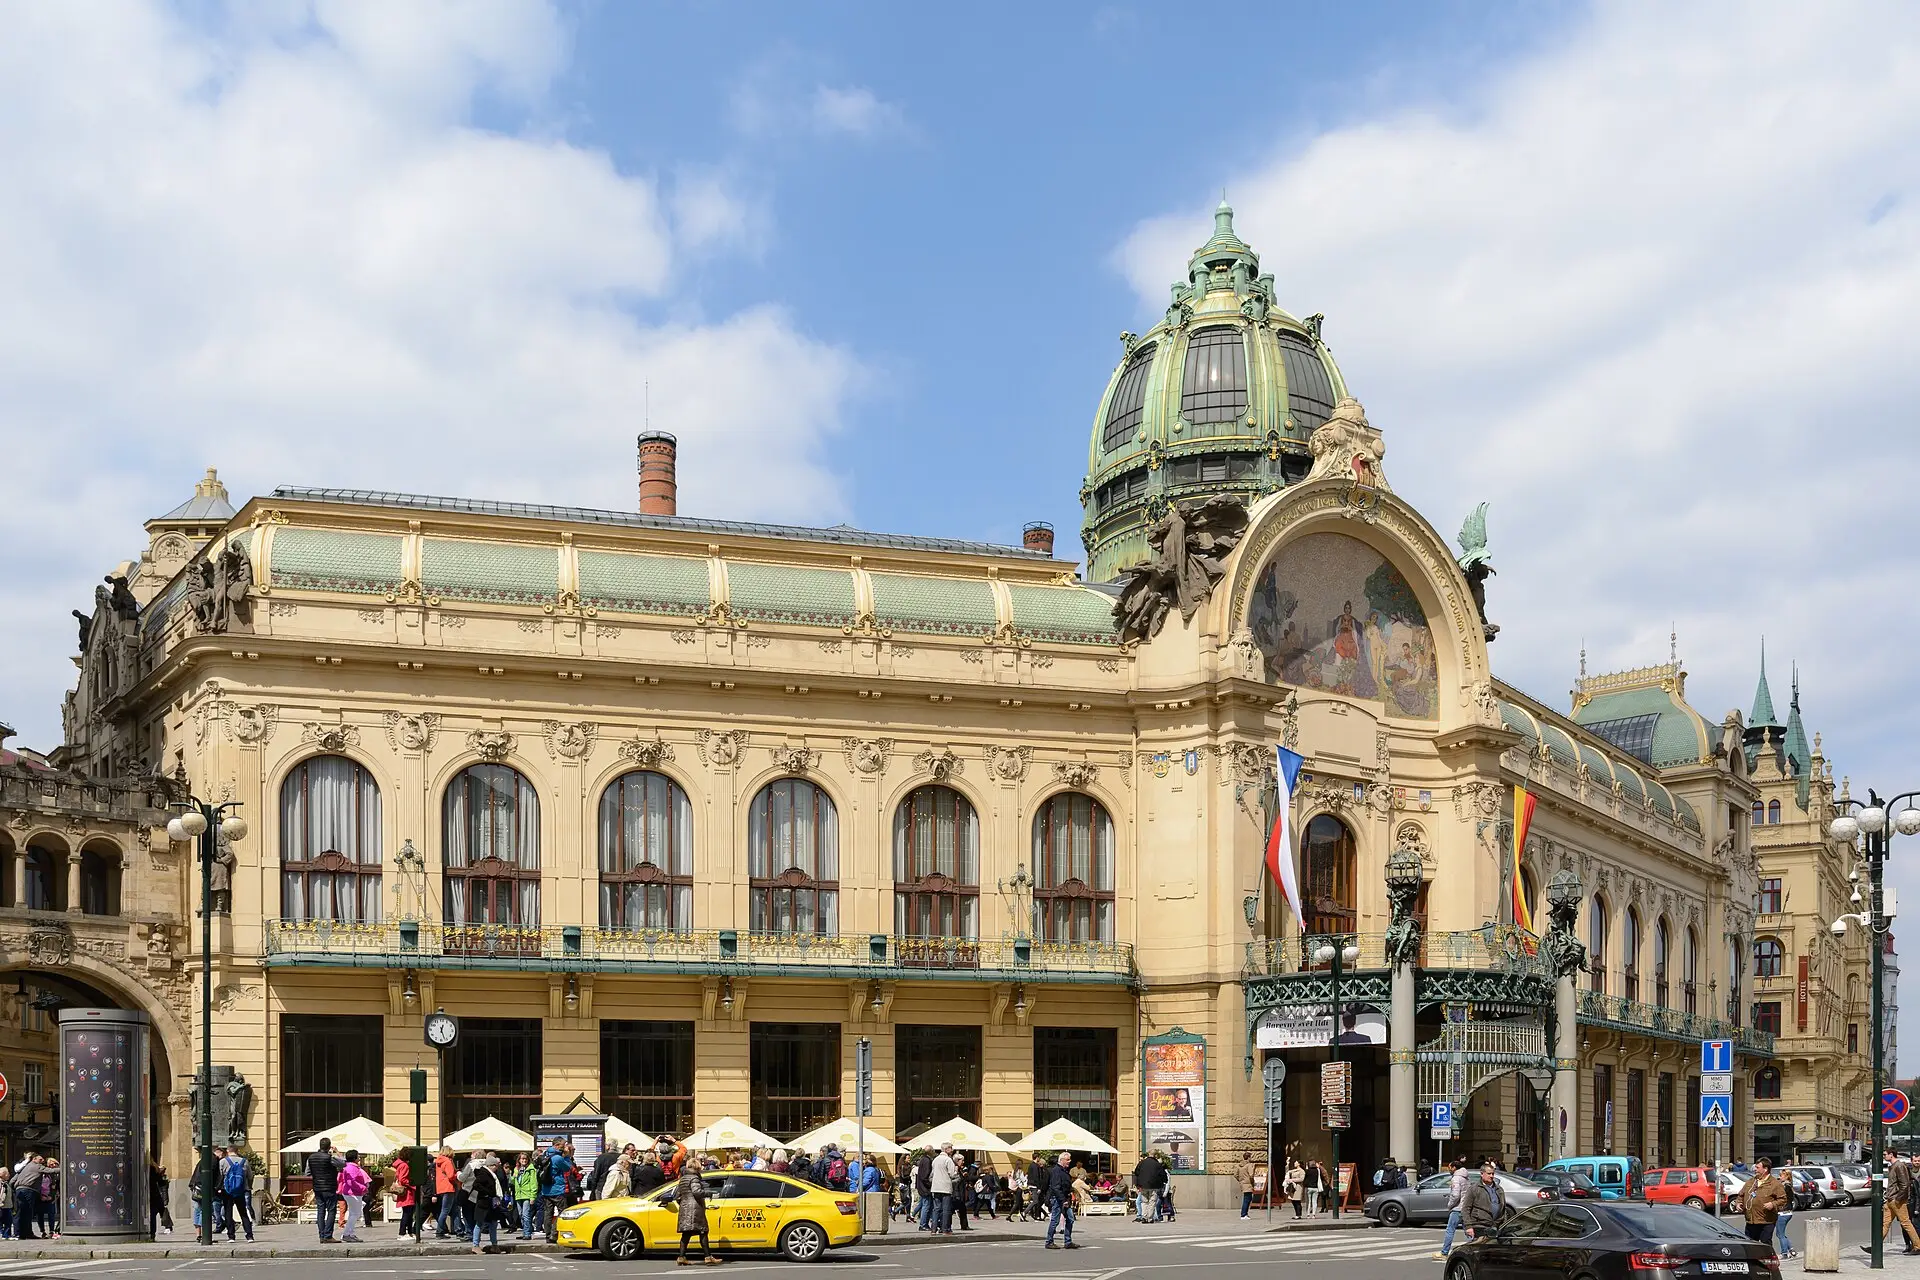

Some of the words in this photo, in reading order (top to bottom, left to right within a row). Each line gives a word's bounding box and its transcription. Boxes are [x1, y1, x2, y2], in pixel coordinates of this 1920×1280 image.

[1799, 980, 1807, 1003] HOTEL
[1436, 1104, 1448, 1120] P
[732, 1208, 766, 1221] AAA
[1726, 1262, 1746, 1270] 5062
